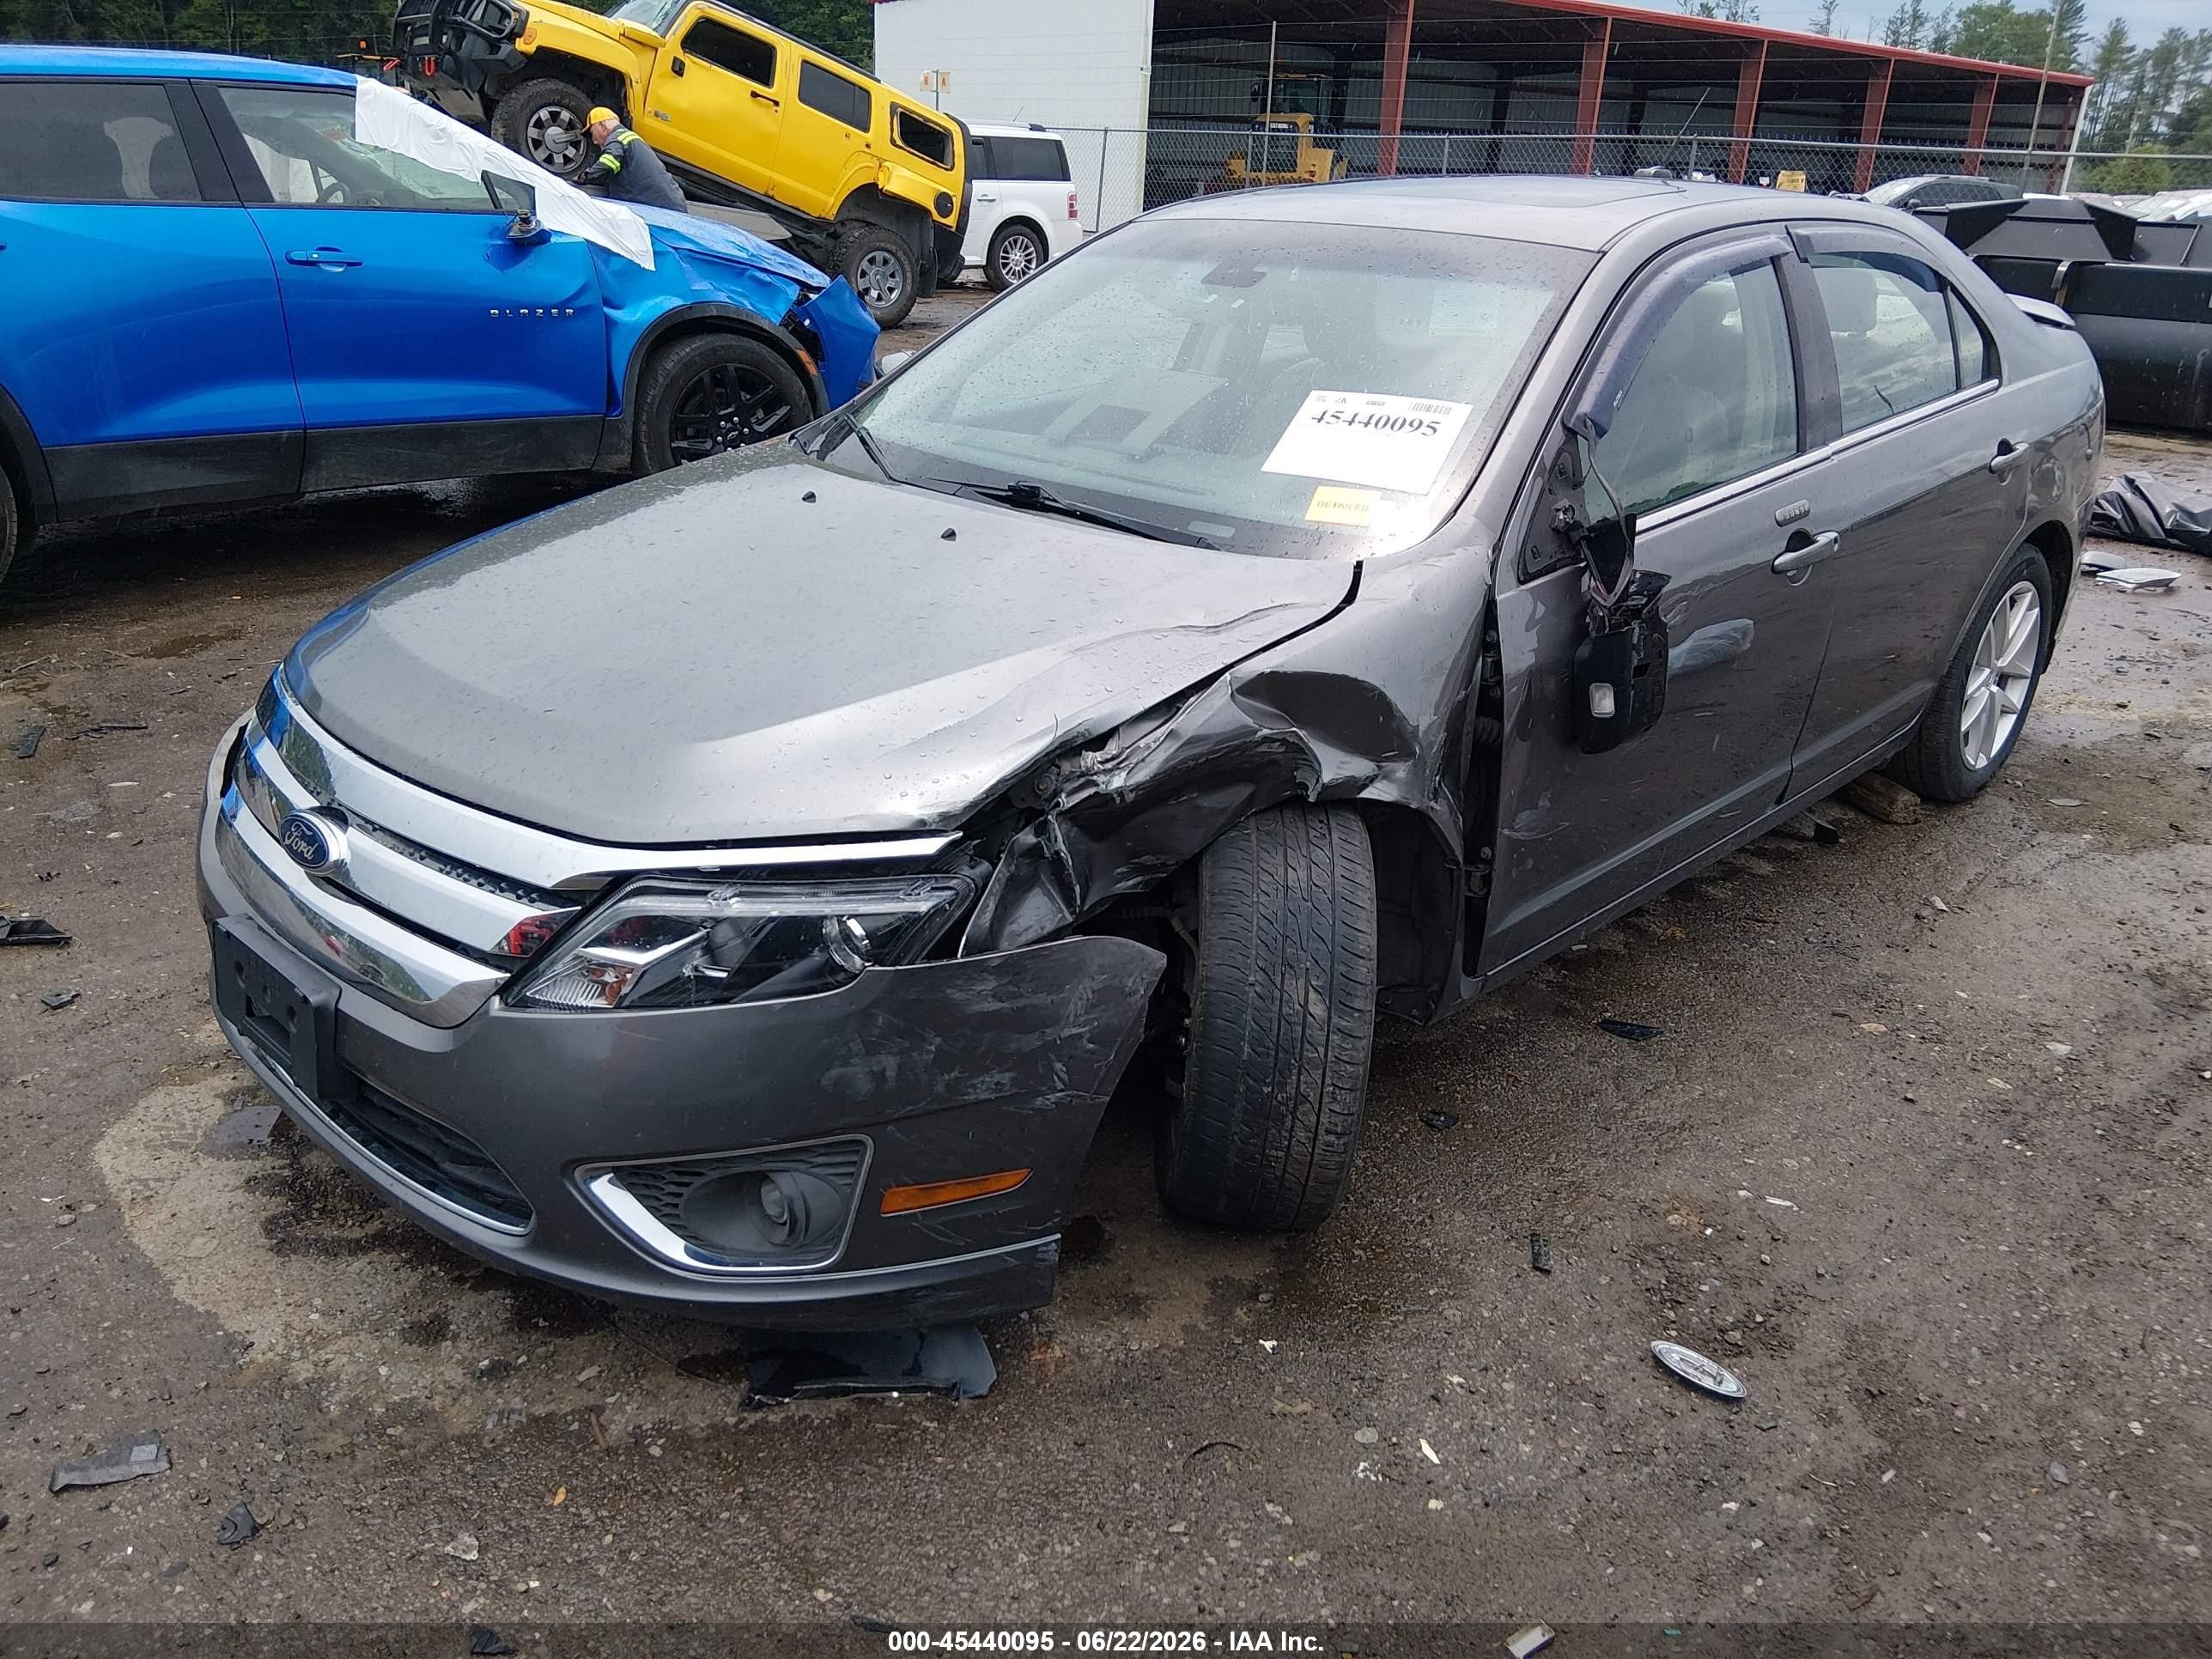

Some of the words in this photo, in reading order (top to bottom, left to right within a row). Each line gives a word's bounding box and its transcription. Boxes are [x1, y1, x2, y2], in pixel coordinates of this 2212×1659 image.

[941, 76, 946, 87] A
[489, 308, 574, 317] BLAZER
[1311, 409, 1442, 437] 45440095
[1316, 501, 1370, 512] DETAILED
[283, 821, 319, 860] Ford
